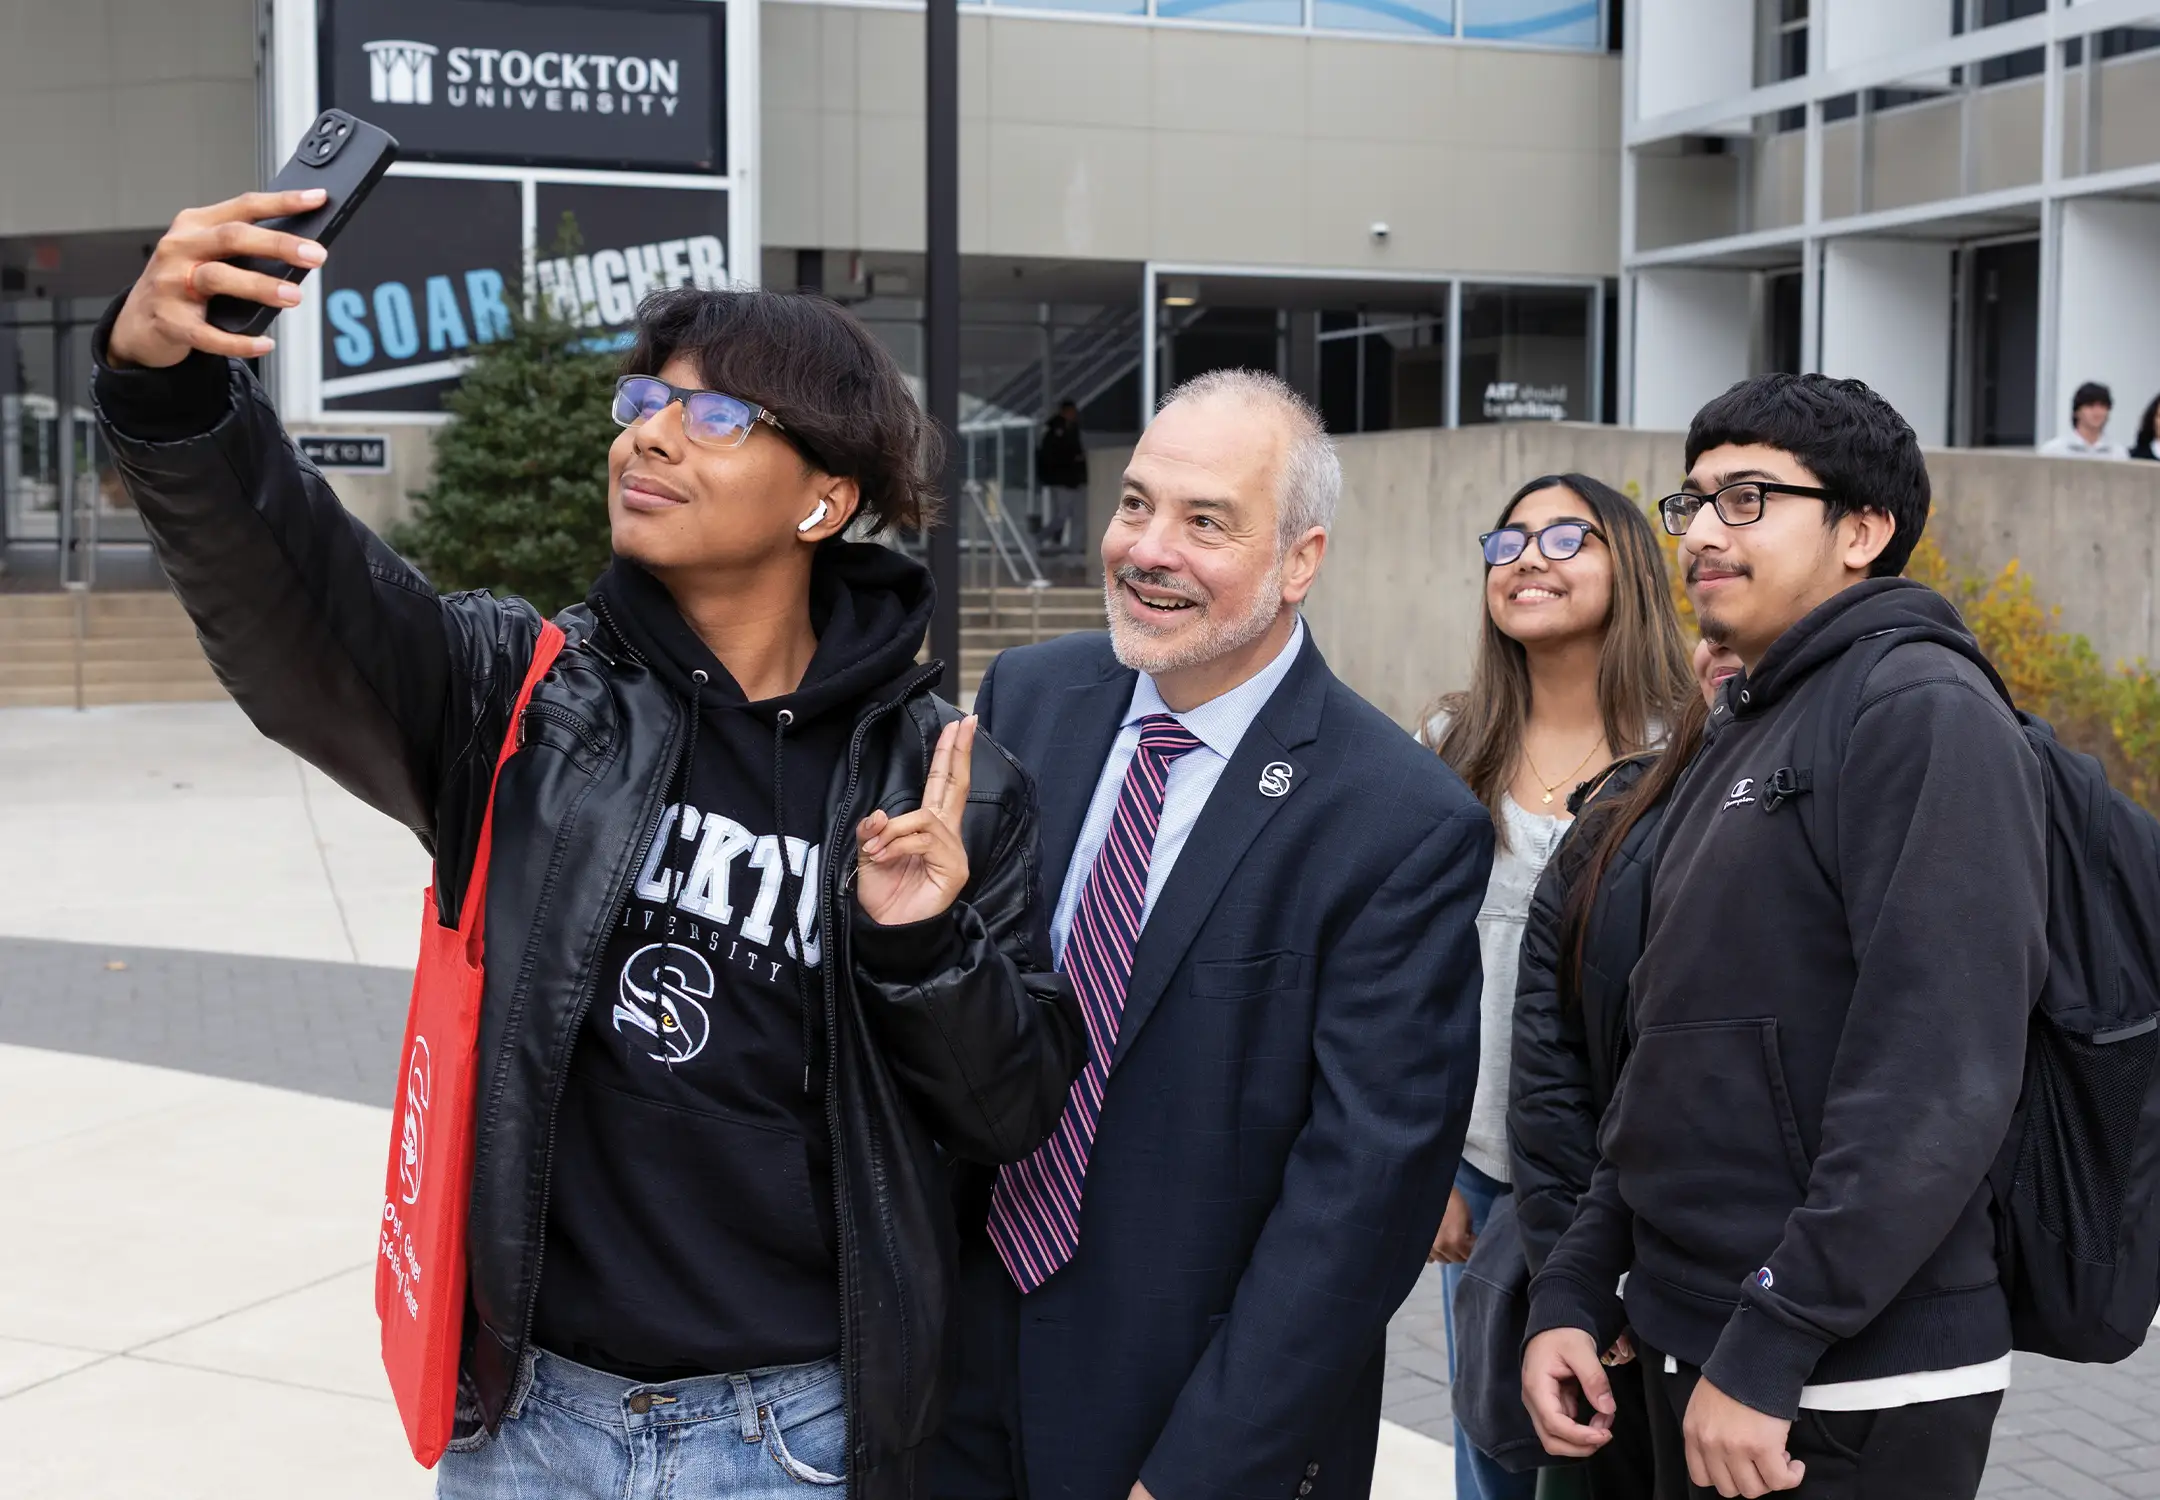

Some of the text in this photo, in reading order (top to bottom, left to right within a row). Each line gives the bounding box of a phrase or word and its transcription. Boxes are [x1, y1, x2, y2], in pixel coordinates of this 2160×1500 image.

[447, 47, 679, 95] STOCKTON
[447, 85, 680, 117] UNIVERSITY
[326, 235, 730, 367] SOAR HIGHER
[1484, 382, 1518, 400] ART
[622, 907, 782, 982] IVERSITY
